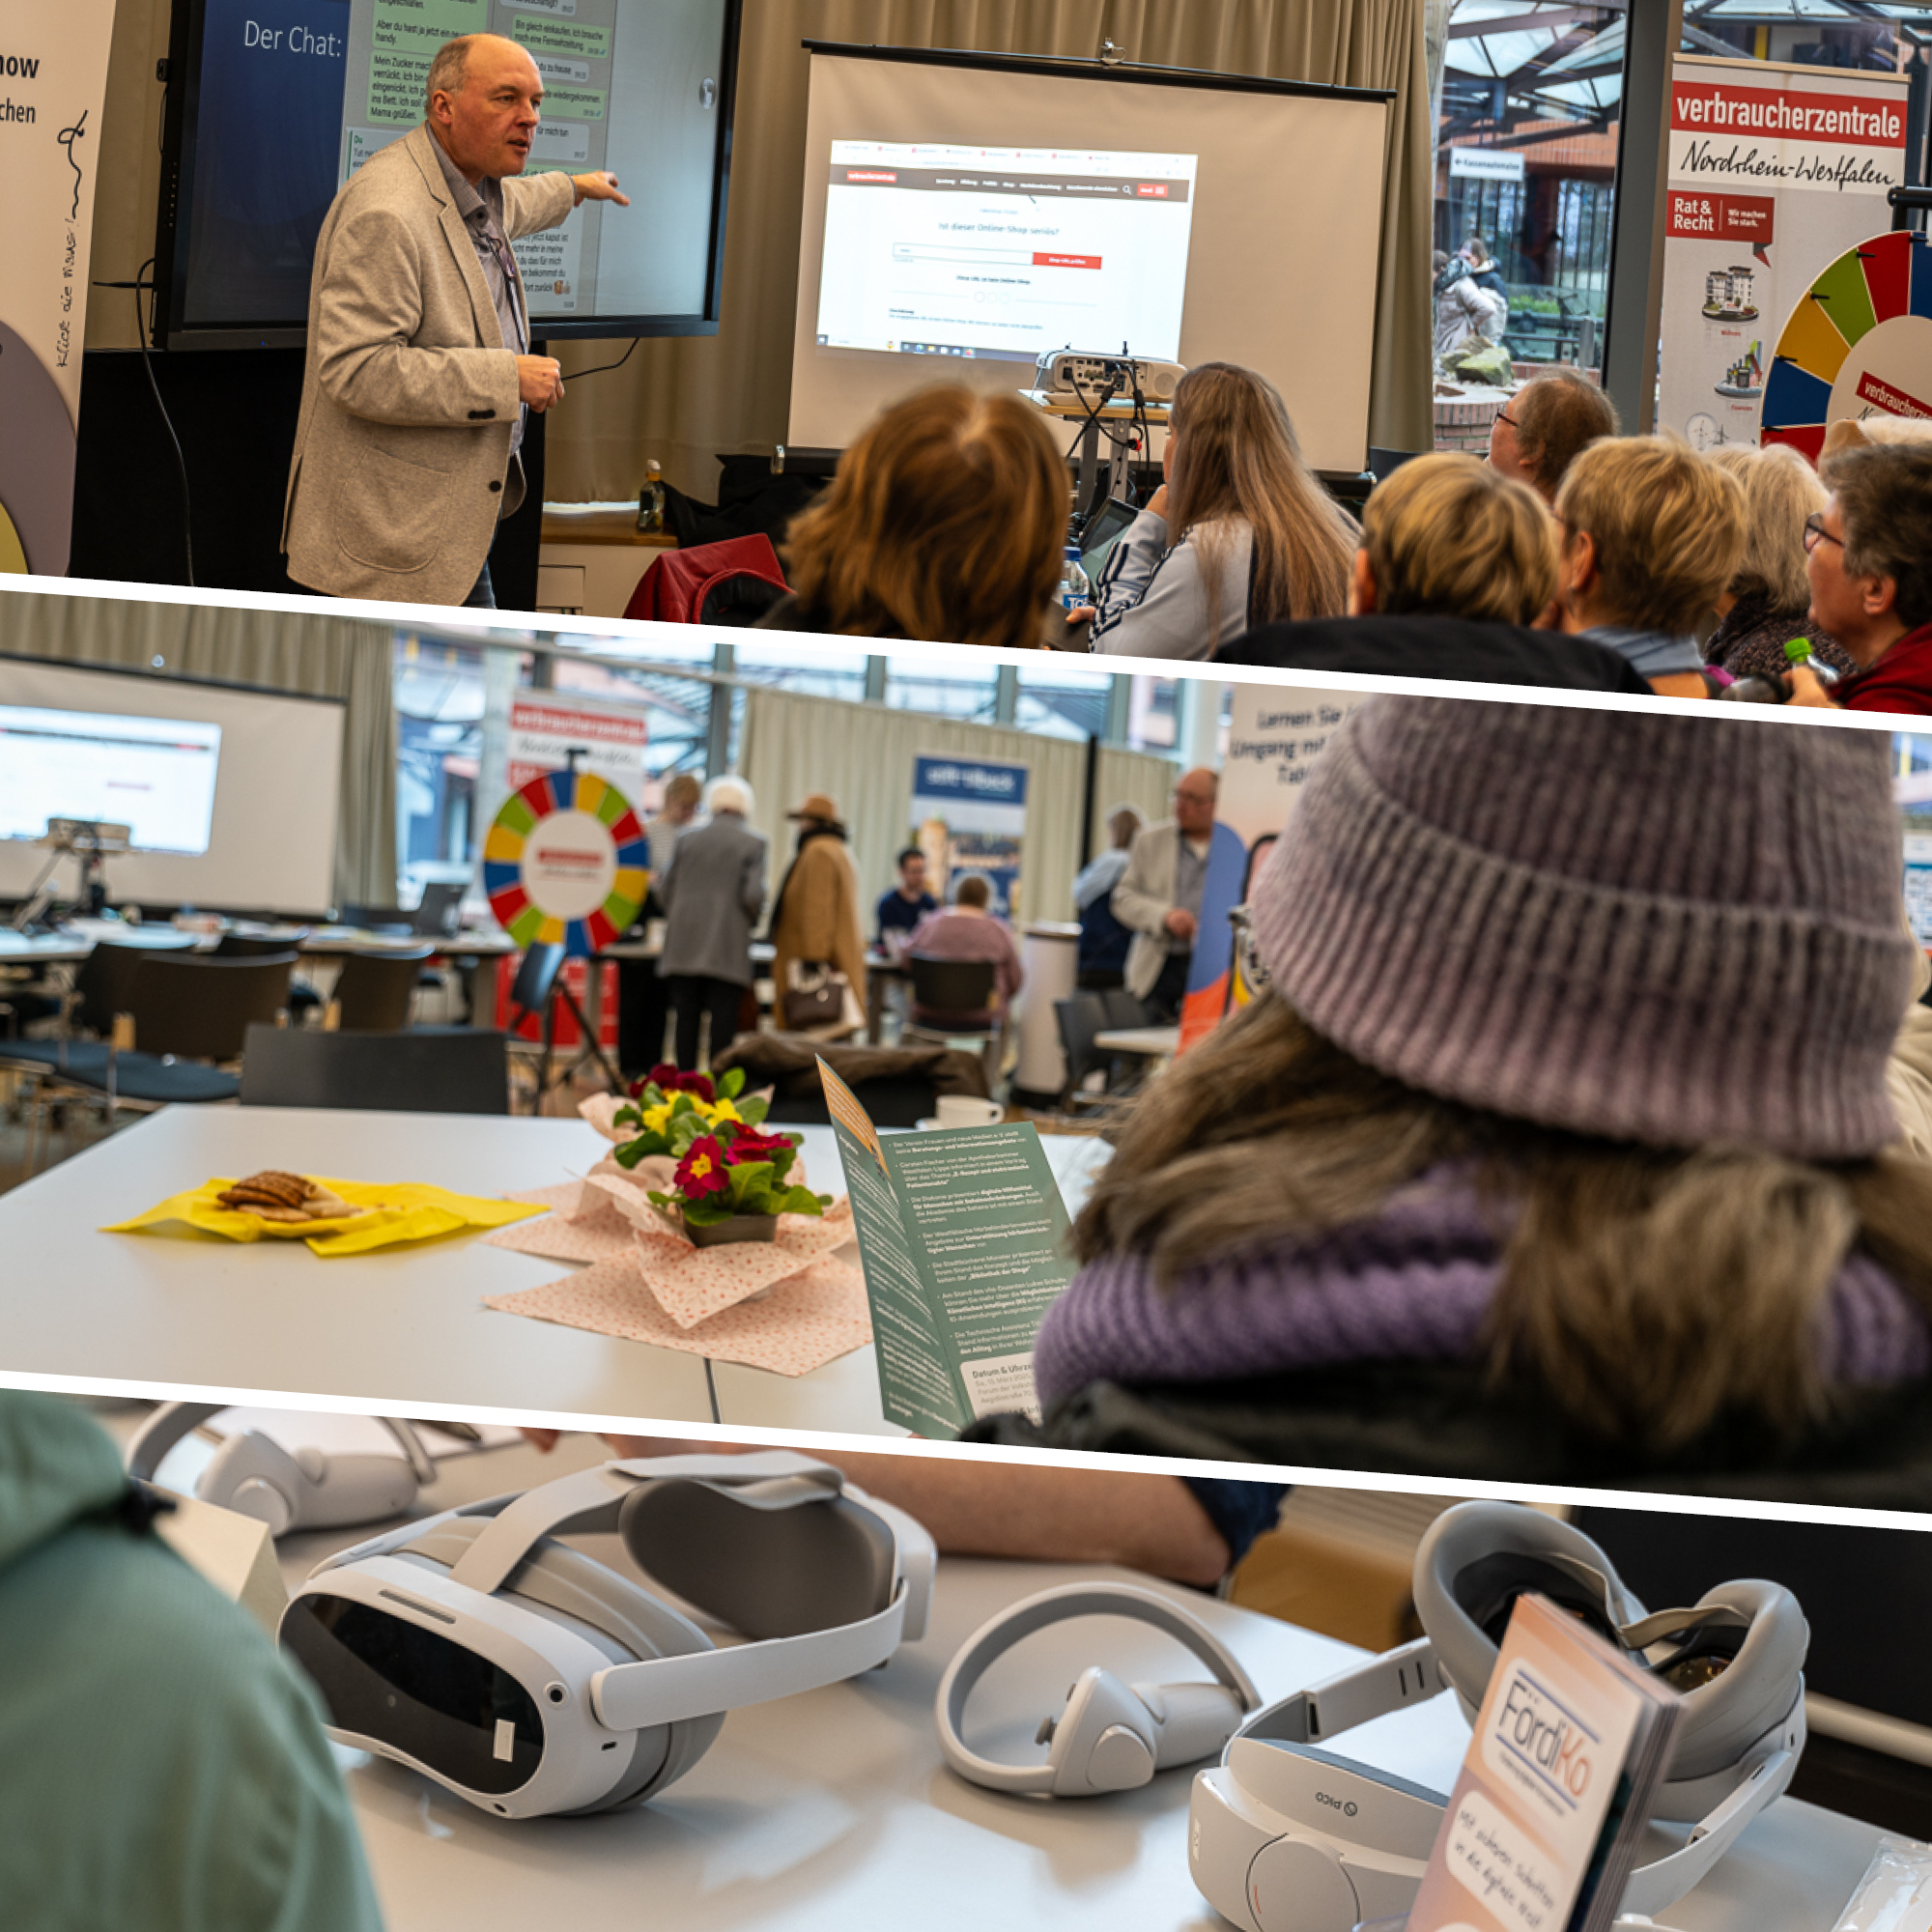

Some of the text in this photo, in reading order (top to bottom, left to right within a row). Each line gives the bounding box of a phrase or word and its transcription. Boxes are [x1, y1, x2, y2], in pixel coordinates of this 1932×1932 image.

[245, 19, 342, 57] Der Chat:
[1677, 91, 1900, 139] verbraucherzentrale
[1681, 139, 1895, 192] Nordrhein-Westfalen
[1673, 197, 1712, 214] Rat &
[951, 222, 976, 232] dieser
[978, 224, 1028, 235] Online-Shop
[1673, 213, 1715, 232] Recht
[1257, 705, 1341, 729] Lernen Sie
[1231, 741, 1295, 761] Umgang
[1278, 764, 1308, 784] Tab
[972, 1368, 1000, 1378] Datum
[1009, 1364, 1034, 1373] Uhrze
[1499, 1679, 1590, 1797] FördiKo
